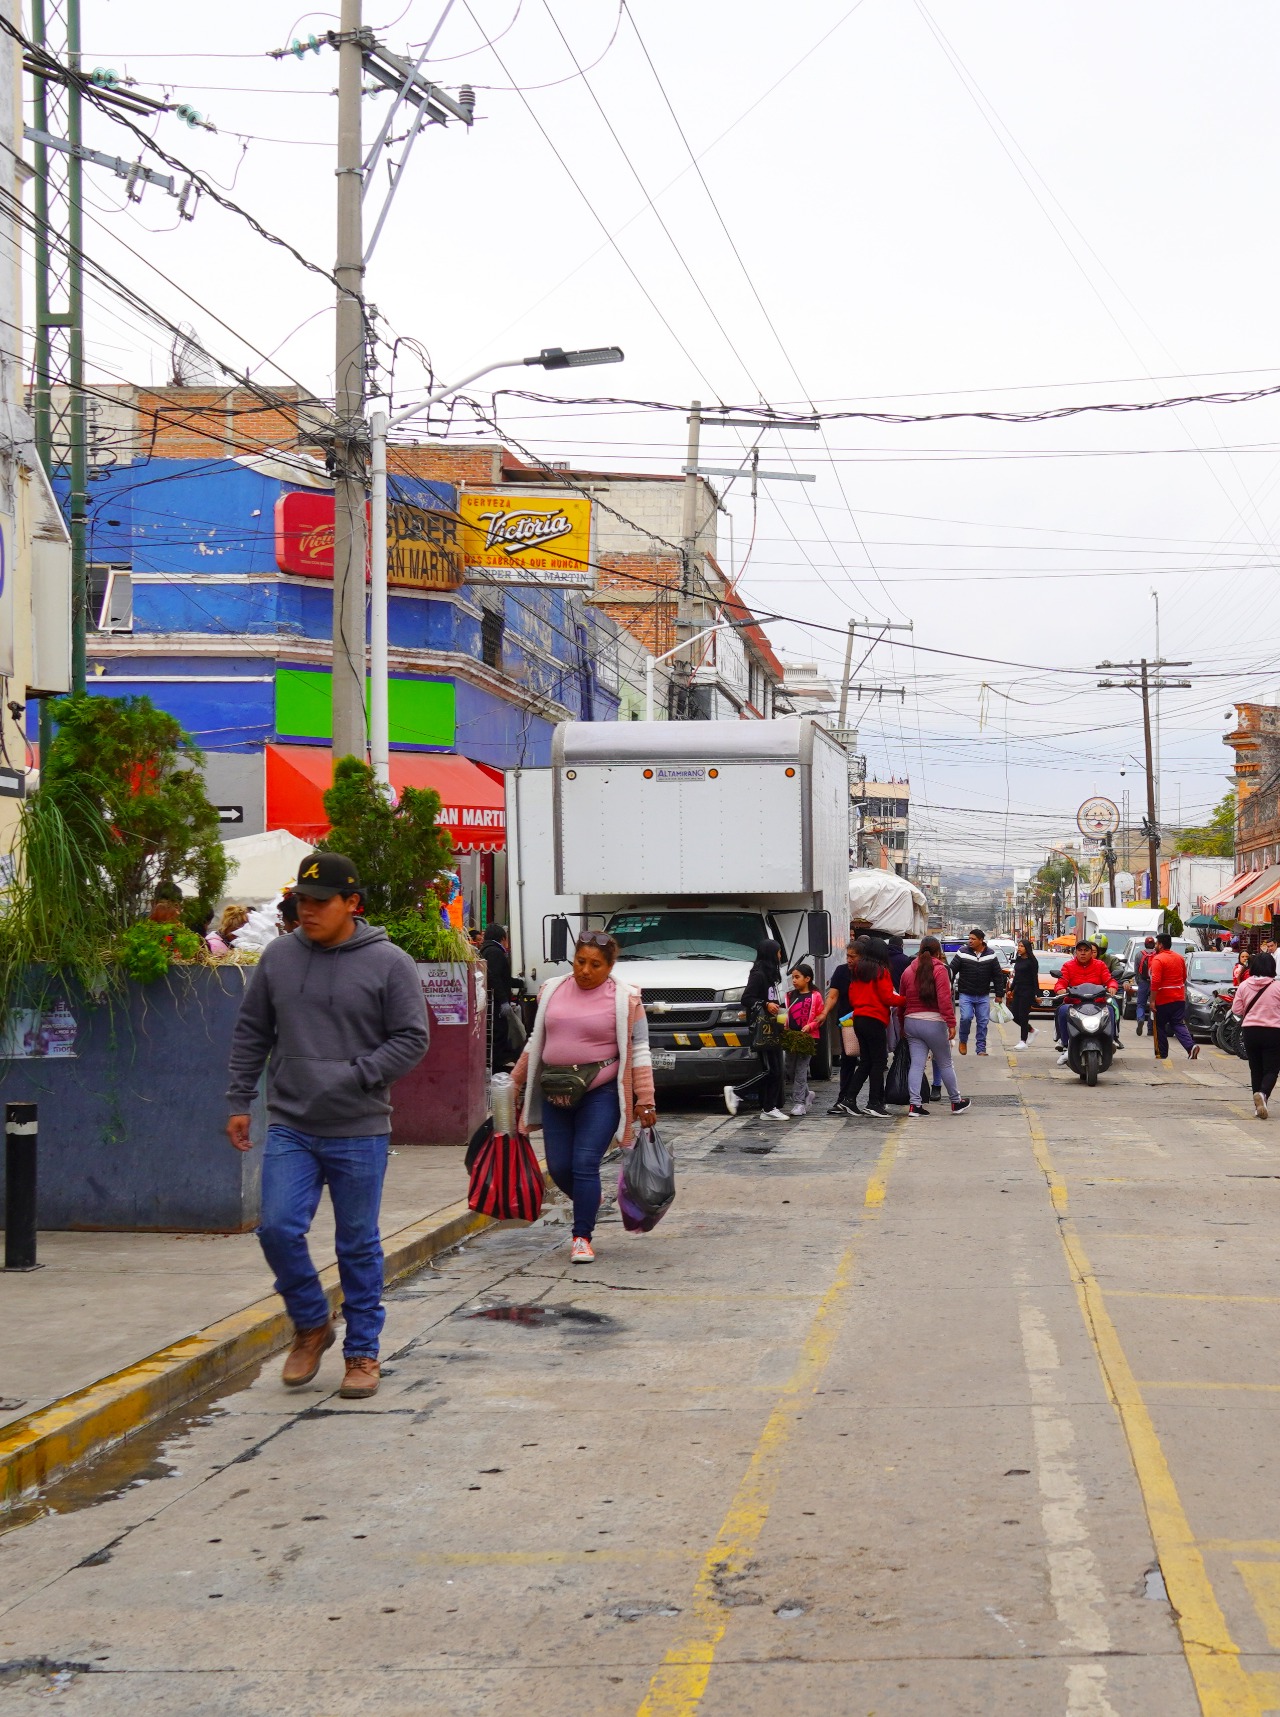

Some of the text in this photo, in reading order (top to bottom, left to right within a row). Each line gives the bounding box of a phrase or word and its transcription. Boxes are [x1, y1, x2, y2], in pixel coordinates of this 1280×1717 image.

[467, 498, 511, 508] CERVEZA
[477, 507, 573, 554] Victoria
[387, 546, 405, 578] AN
[530, 559, 547, 568] QUE
[517, 570, 537, 581] SAN
[543, 571, 587, 583] MARTIN
[657, 769, 704, 778] ALTAMIRANO
[433, 807, 459, 825] SAN
[421, 979, 462, 987] LAUDIA
